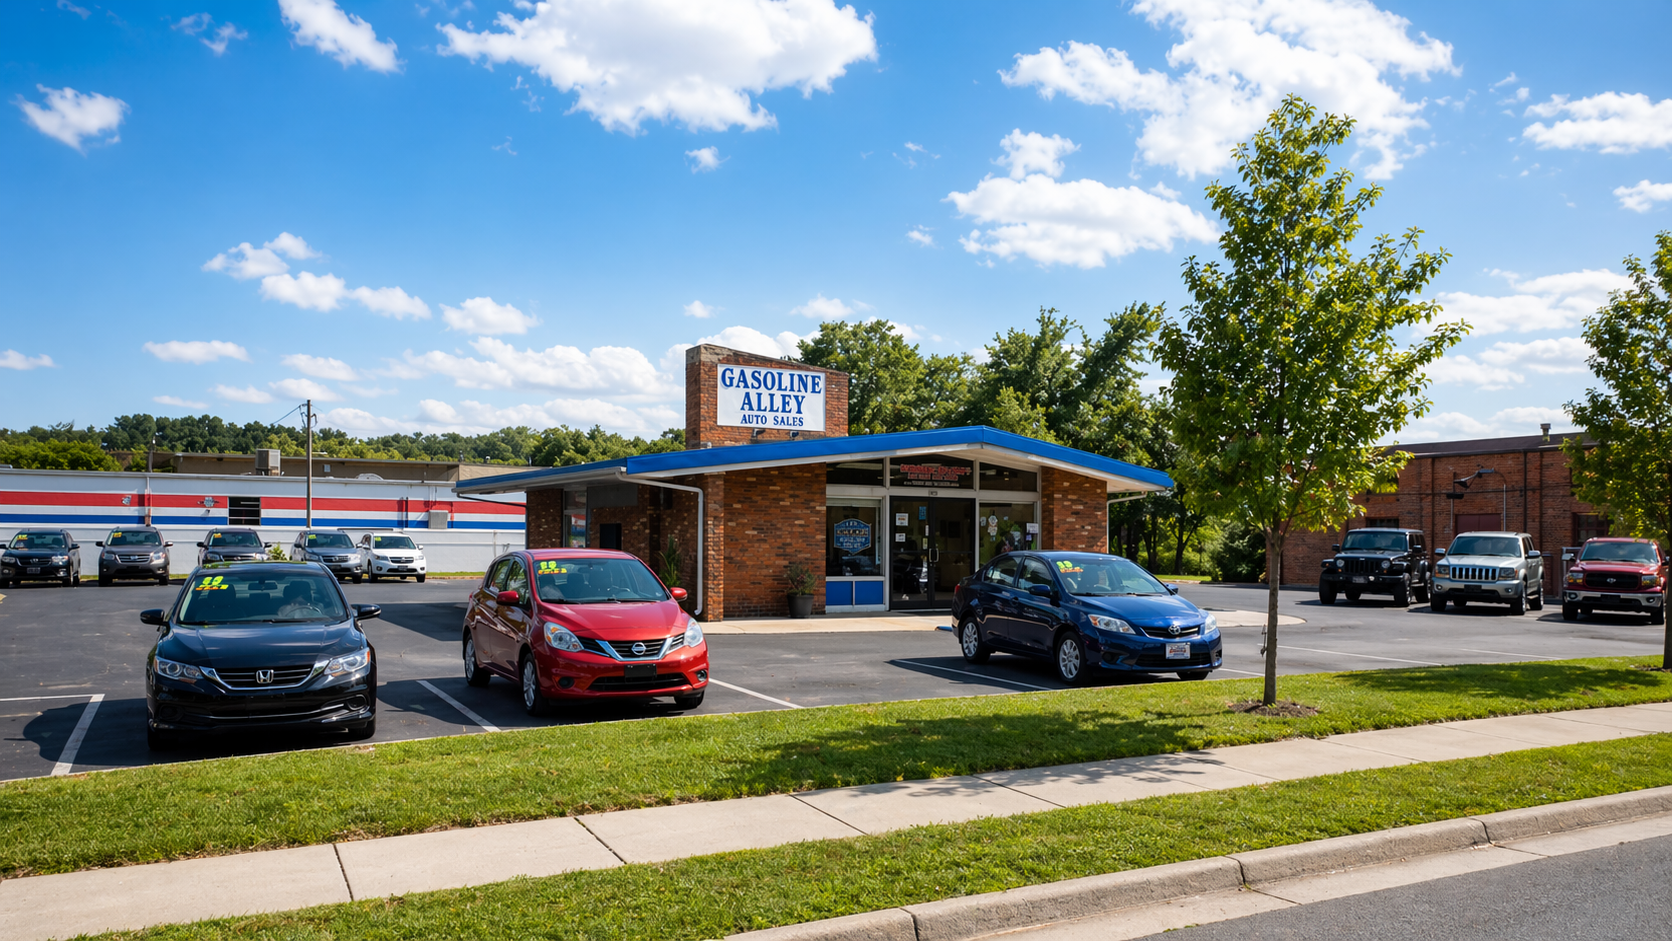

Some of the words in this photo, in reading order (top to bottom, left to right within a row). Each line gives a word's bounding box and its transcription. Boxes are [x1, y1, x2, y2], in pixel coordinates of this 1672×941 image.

[721, 367, 822, 394] GASOLINE
[740, 391, 806, 414] ALLEY
[740, 414, 768, 425] AUTO
[773, 416, 804, 427] SALES
